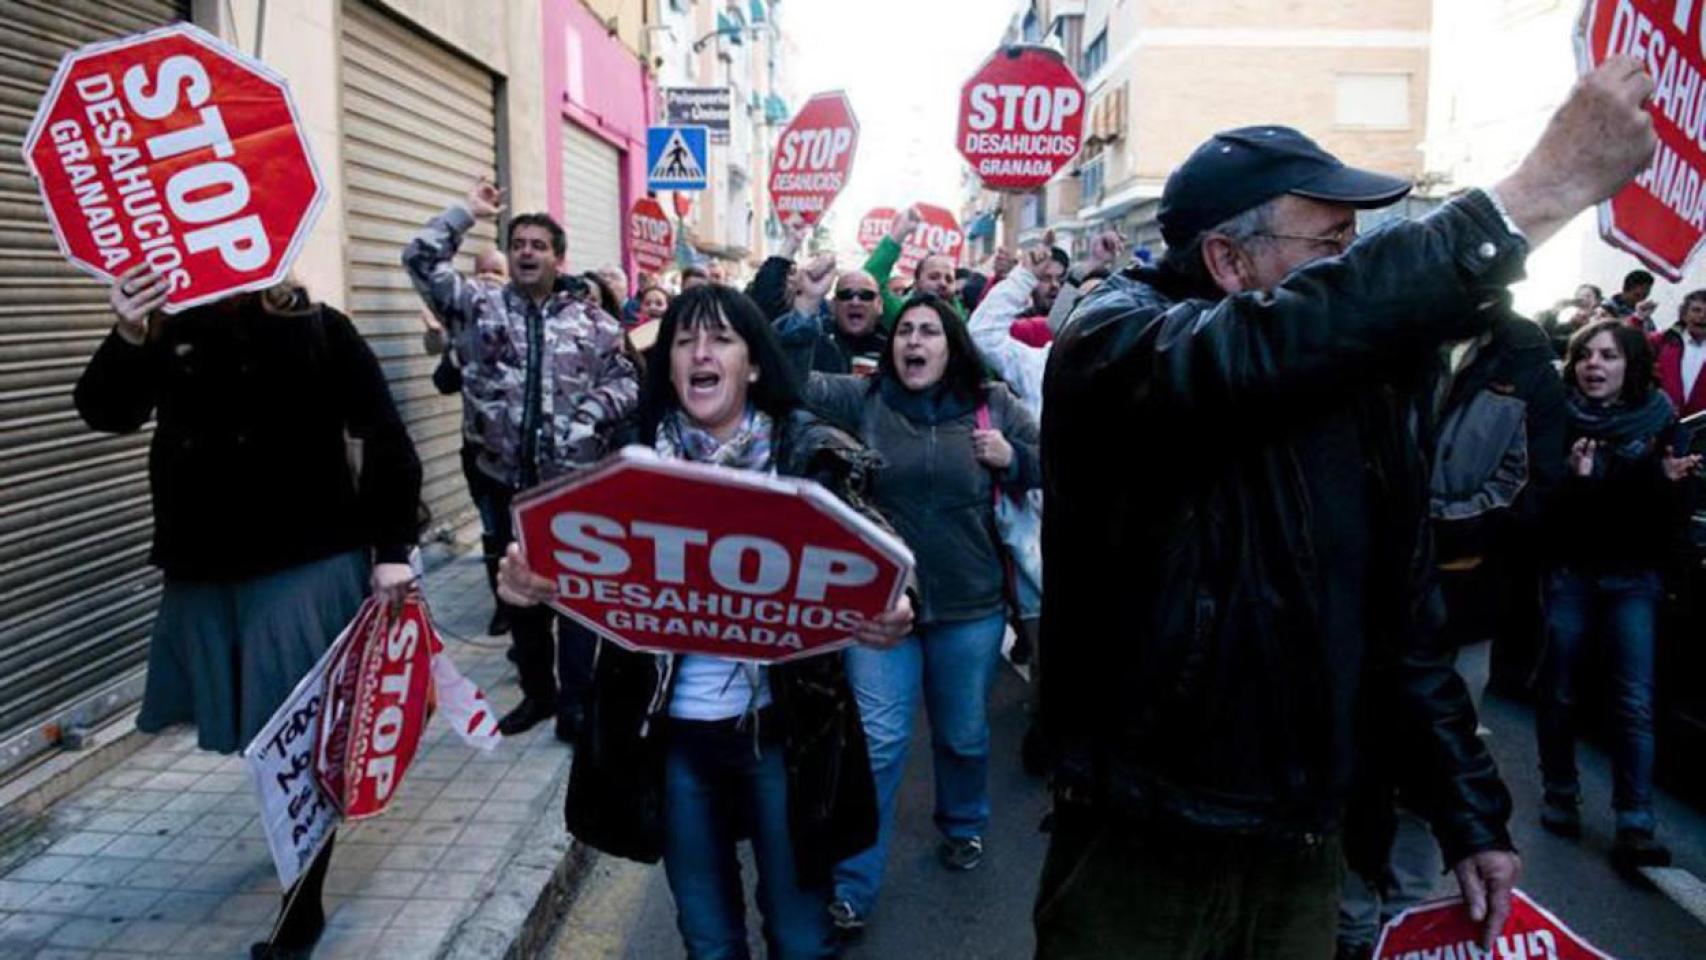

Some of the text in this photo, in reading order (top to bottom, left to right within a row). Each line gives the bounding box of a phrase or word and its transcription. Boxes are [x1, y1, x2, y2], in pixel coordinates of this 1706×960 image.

[968, 84, 1080, 131] STOP
[124, 55, 271, 272] STOP
[779, 128, 850, 170] STOP
[966, 134, 1076, 156] DESAHUCIOS
[980, 160, 1053, 176] GRANADA
[51, 120, 130, 269] GRANADA
[76, 73, 191, 294] DESAHUCIOS
[632, 214, 666, 246] STOP
[550, 511, 878, 601] STOP
[557, 574, 866, 630] DESAHUCIOS
[606, 609, 804, 649] GRANADA
[366, 619, 419, 800] STOP
